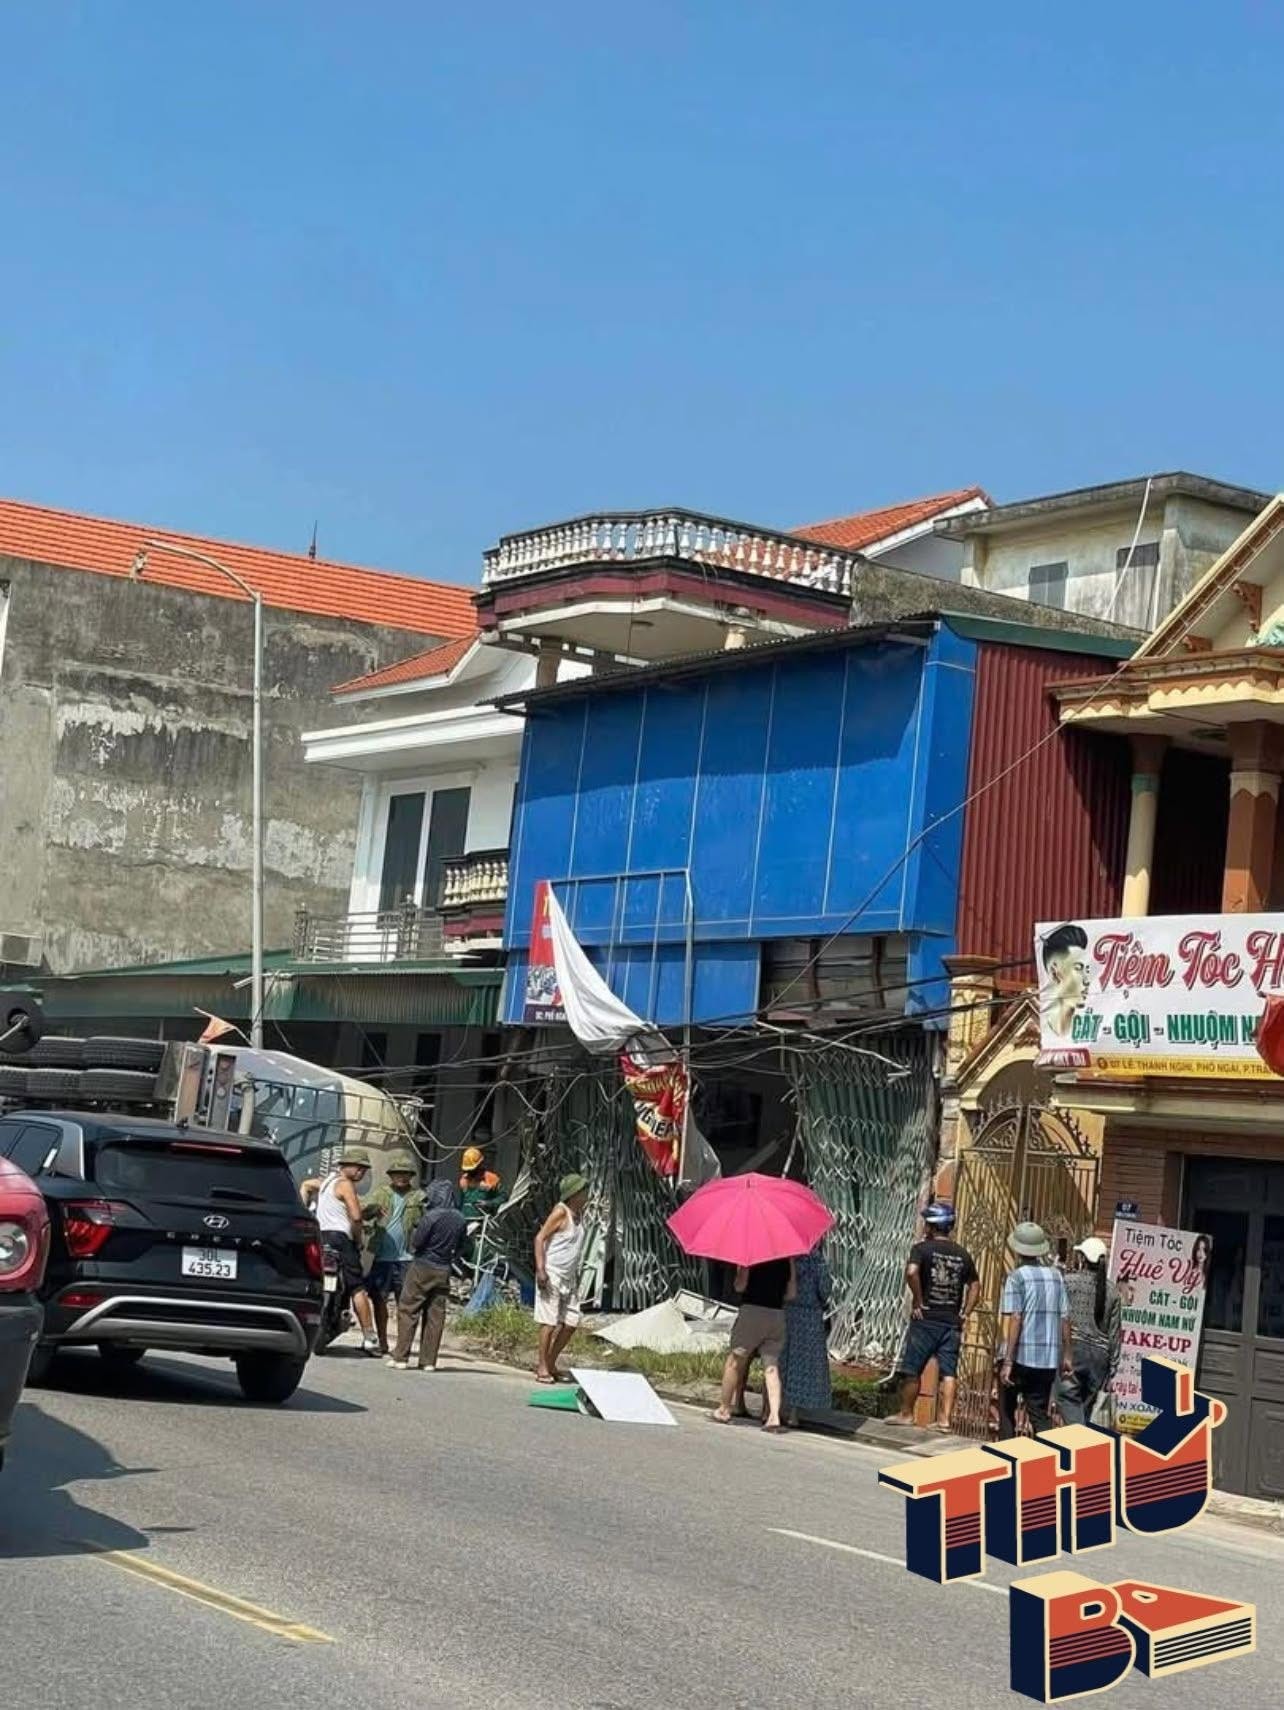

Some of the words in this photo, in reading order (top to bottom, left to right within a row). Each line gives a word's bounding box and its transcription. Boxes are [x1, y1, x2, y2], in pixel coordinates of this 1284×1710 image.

[1094, 932, 1175, 999] Tiệm
[1179, 930, 1244, 991] Tóc
[1246, 930, 1284, 990] H
[1072, 1007, 1103, 1043] CẮT
[1114, 1009, 1150, 1048] GỘI
[1167, 1010, 1238, 1050] NHUỘM
[1125, 1228, 1155, 1248] Tiệm
[1160, 1234, 1184, 1252] Tóc
[188, 1261, 231, 1277] 435.23
[1159, 1313, 1180, 1329] NAM
